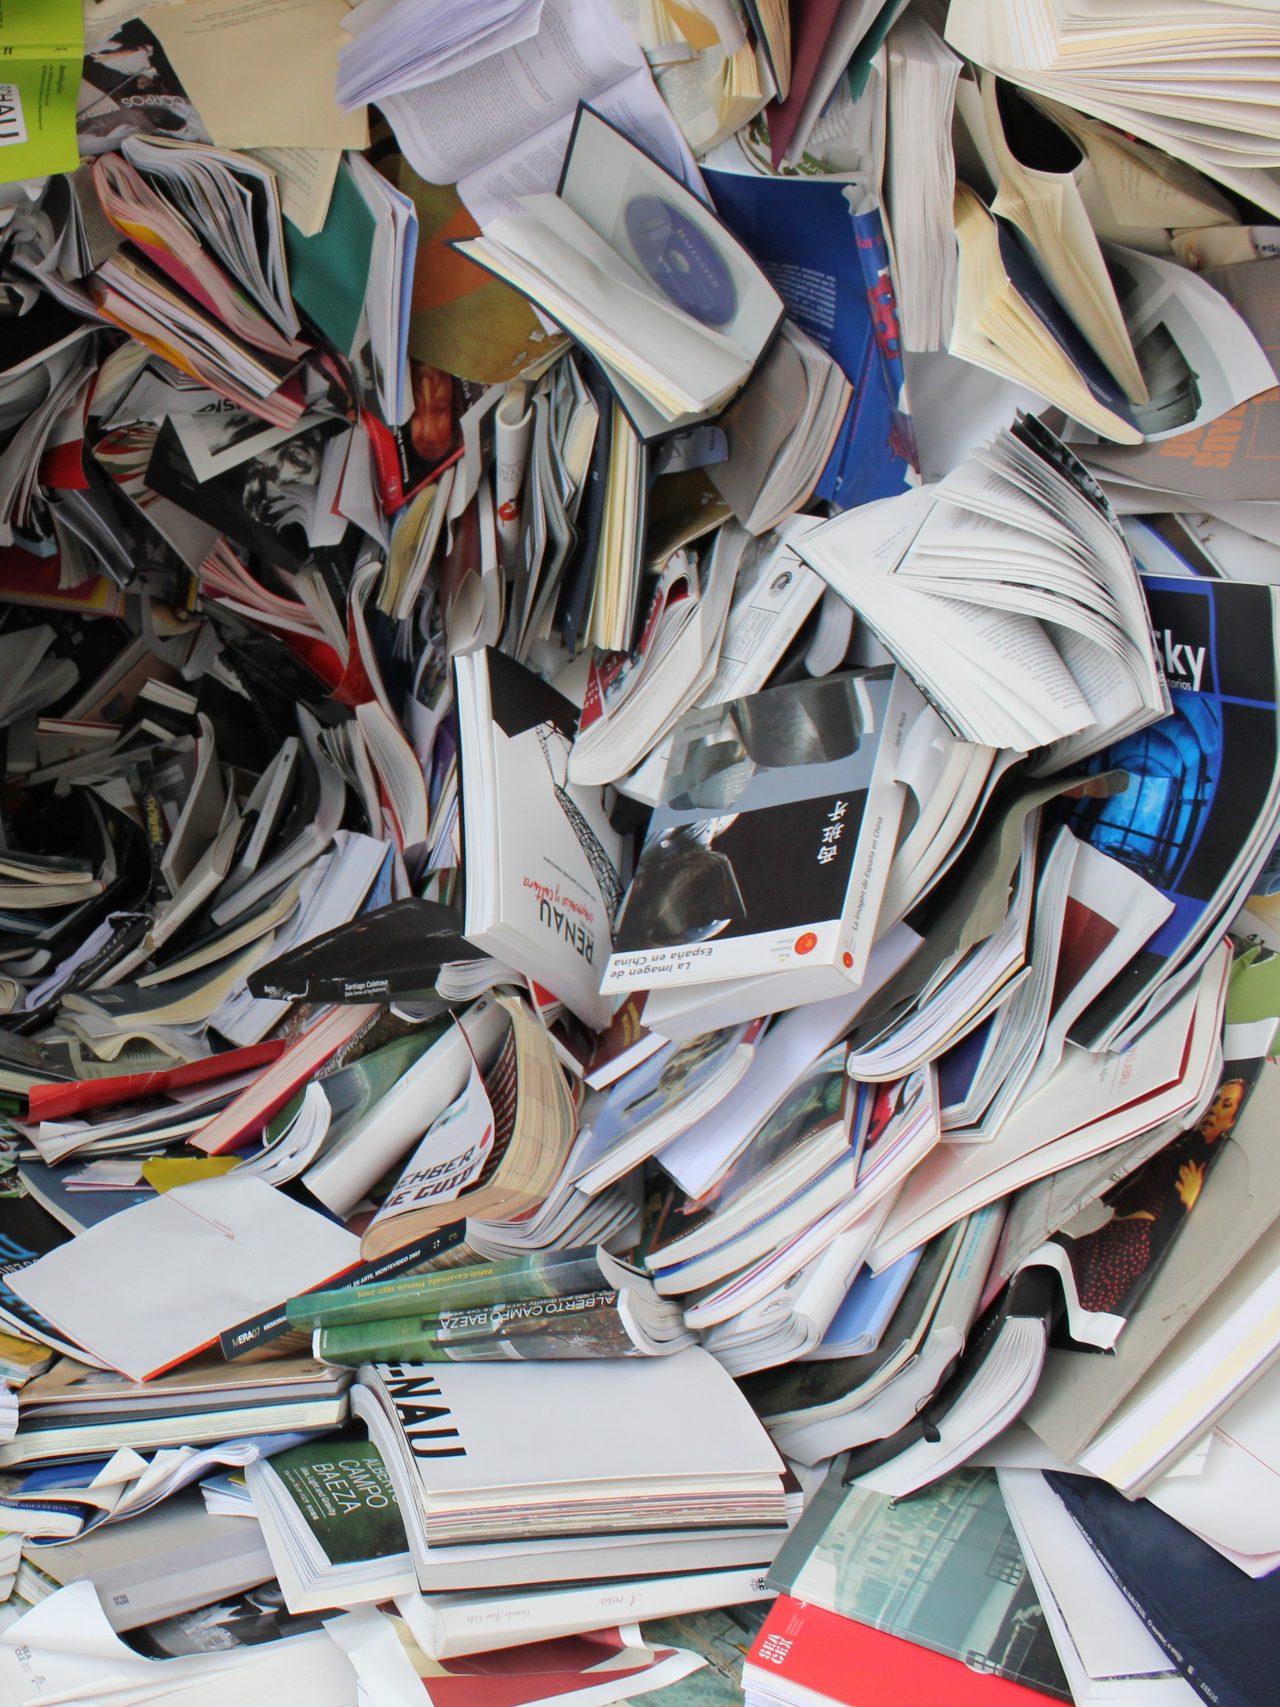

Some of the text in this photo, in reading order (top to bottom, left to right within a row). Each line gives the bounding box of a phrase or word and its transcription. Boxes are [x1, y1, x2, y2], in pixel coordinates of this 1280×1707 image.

[813, 798, 849, 867] 西班牙
[540, 900, 593, 965] RENAU
[613, 945, 714, 969] España en China
[677, 960, 692, 971] La
[609, 969, 625, 979] de
[373, 1256, 409, 1277] MONTEVIDEO
[439, 1294, 614, 1329] ALBERTO CAMPO BAEZA
[311, 1463, 359, 1514] BAEZA
[336, 1461, 386, 1506] CAMPO
[19, 1643, 32, 1660] SEA
[757, 1630, 781, 1661] SEA
[770, 1636, 793, 1666] CEX
